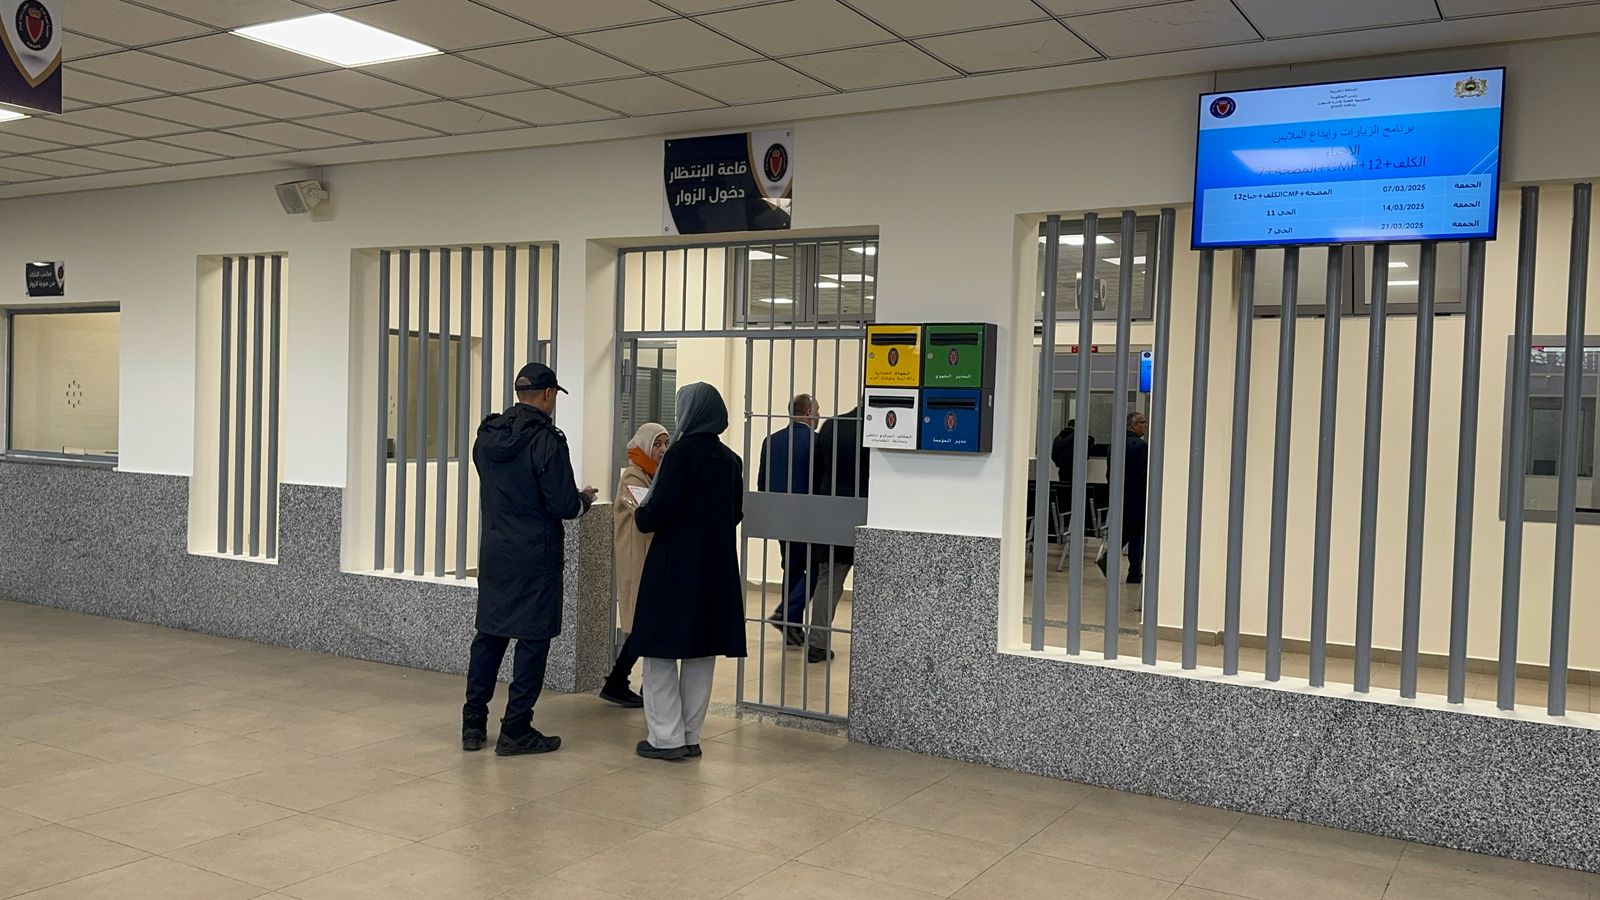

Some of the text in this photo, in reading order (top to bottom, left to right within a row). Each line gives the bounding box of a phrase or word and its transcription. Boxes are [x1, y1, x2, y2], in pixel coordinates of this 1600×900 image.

[1273, 131, 1306, 143] الملابس
[1340, 124, 1378, 138] الزيارات
[1383, 124, 1414, 137] برنامج
[668, 164, 714, 184] الإنتظار
[718, 160, 747, 176] قاعة
[1383, 184, 1426, 192] 07/03/2025
[675, 186, 745, 206] دخول الزوار
[1383, 203, 1424, 211] 14/03/2025
[1381, 222, 1424, 230] 21/03/2025
